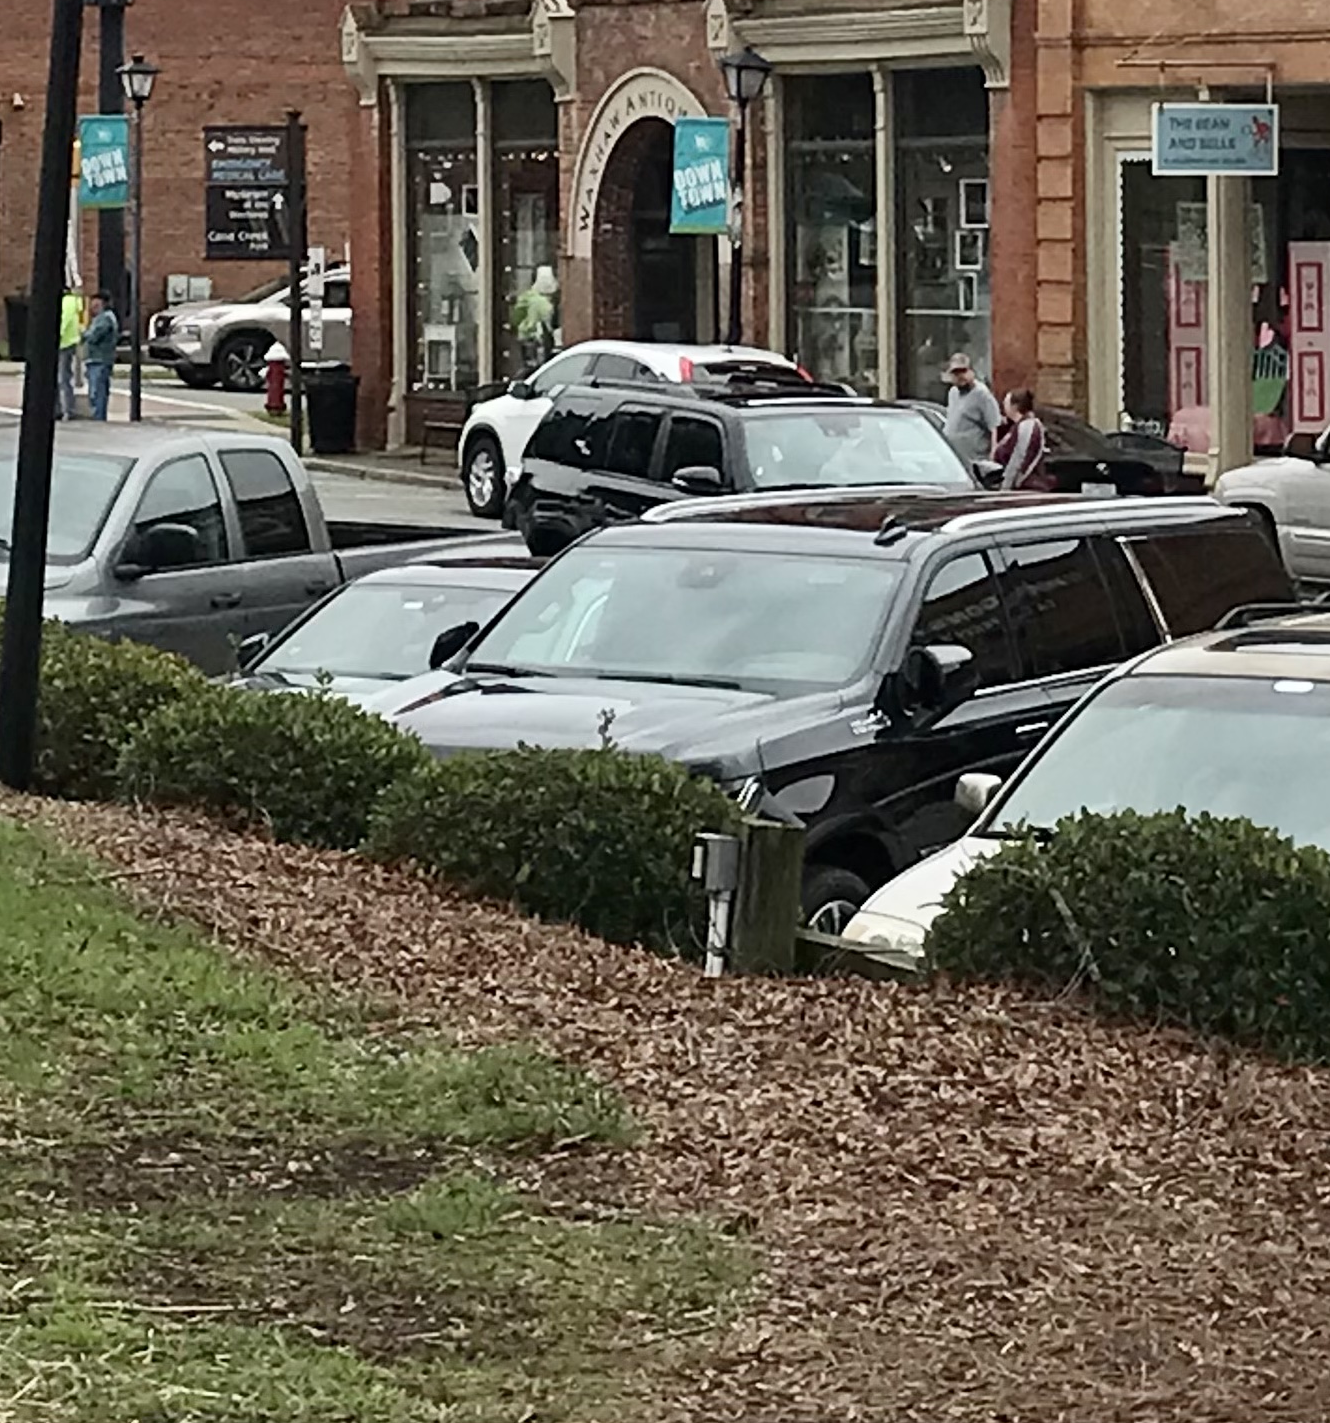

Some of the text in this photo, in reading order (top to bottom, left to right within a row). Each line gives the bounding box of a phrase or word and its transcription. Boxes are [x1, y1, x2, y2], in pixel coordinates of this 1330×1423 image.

[1169, 117, 1192, 131] THE
[81, 148, 124, 178] DOWN
[85, 165, 127, 188] TOWN
[579, 110, 620, 232] WAXHAW
[674, 159, 723, 192] DOWN
[678, 180, 726, 211] TOWN
